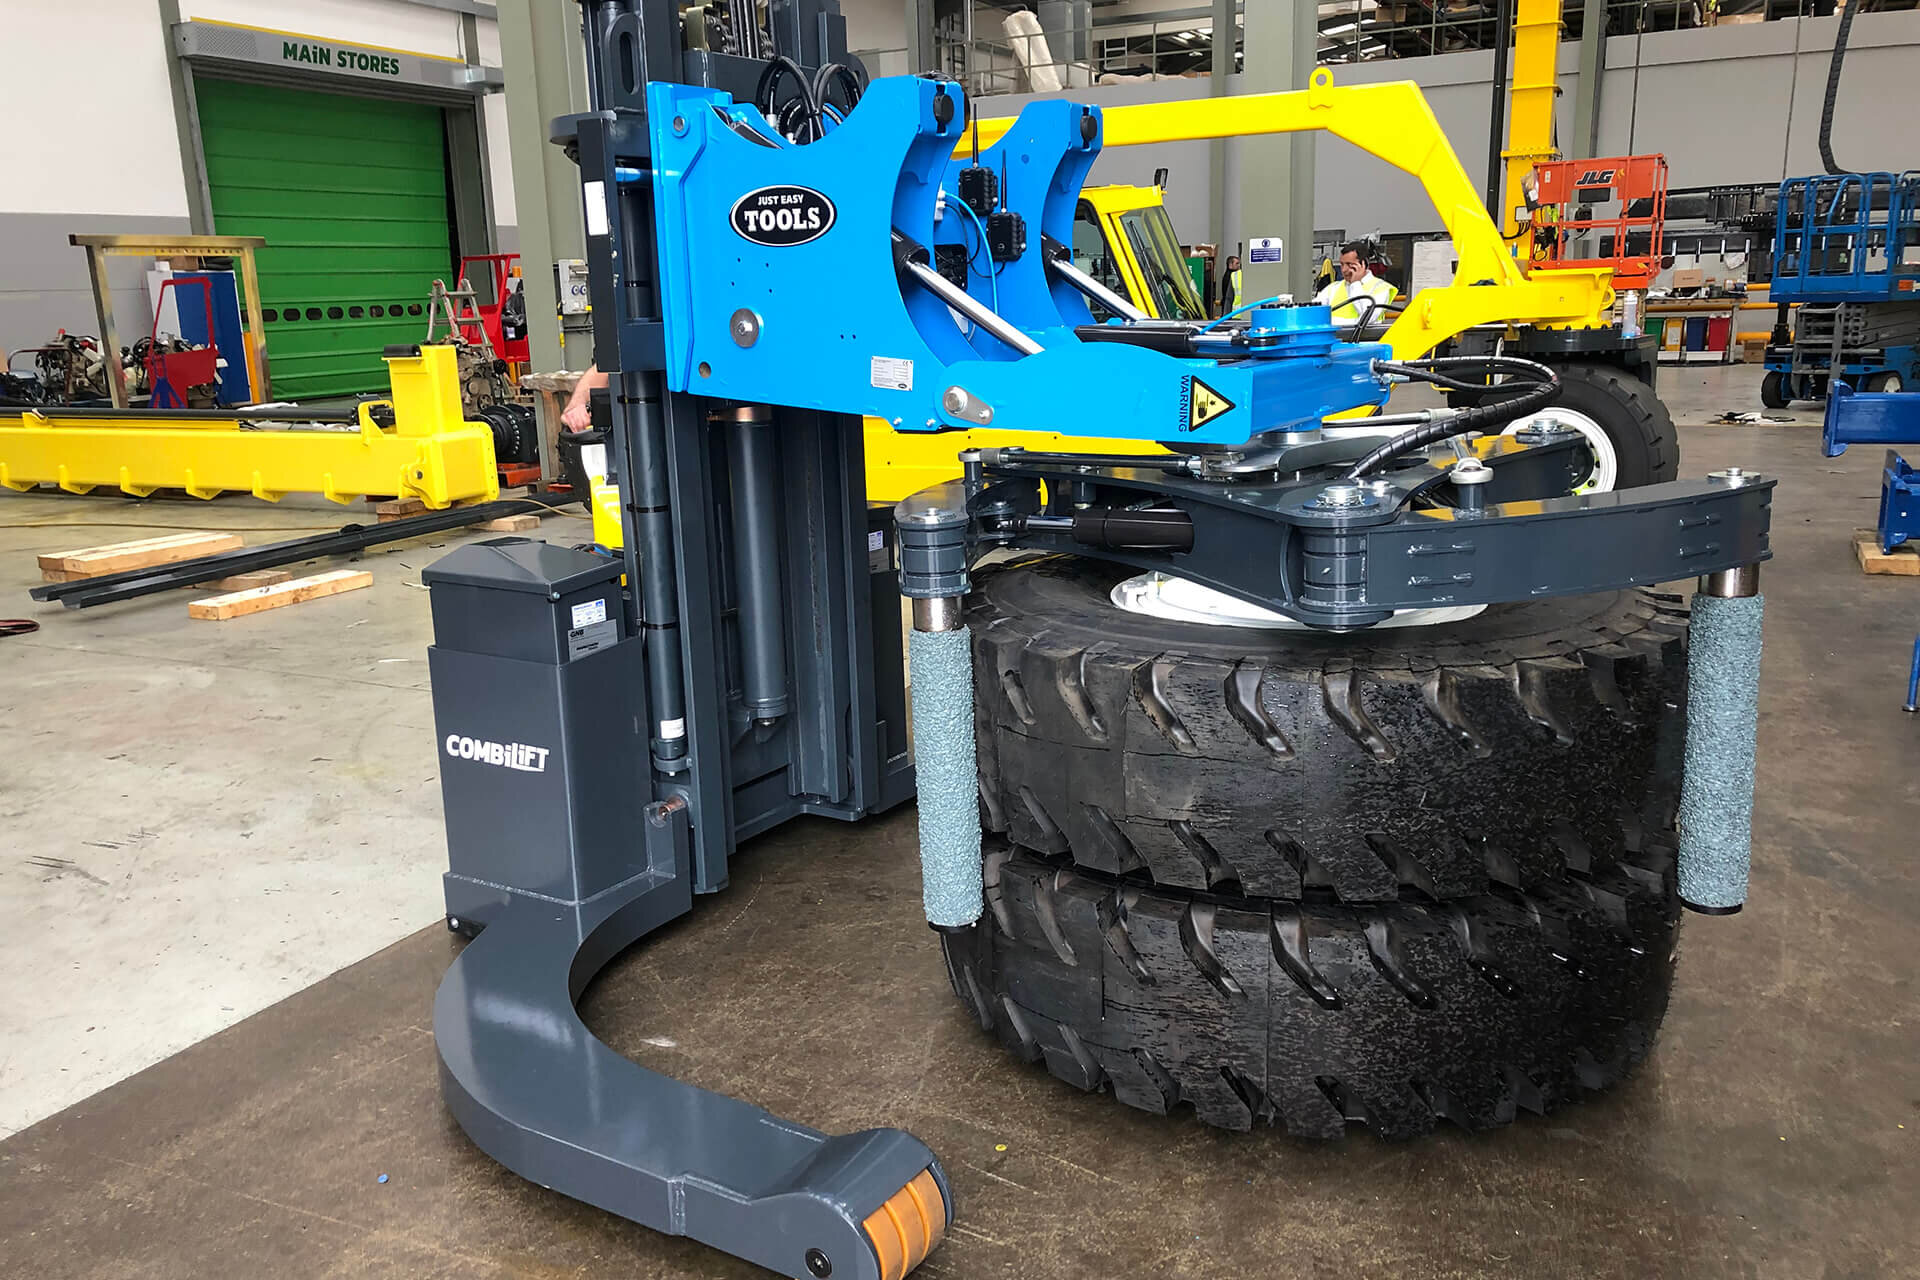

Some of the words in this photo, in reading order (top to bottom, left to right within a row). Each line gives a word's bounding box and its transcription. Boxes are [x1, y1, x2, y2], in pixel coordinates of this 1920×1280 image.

[337, 50, 400, 76] STORES
[1575, 169, 1616, 186] JLG
[758, 195, 779, 206] JUST
[780, 194, 804, 205] EASY
[744, 207, 821, 232] TOOLS
[1178, 374, 1190, 432] WARNING
